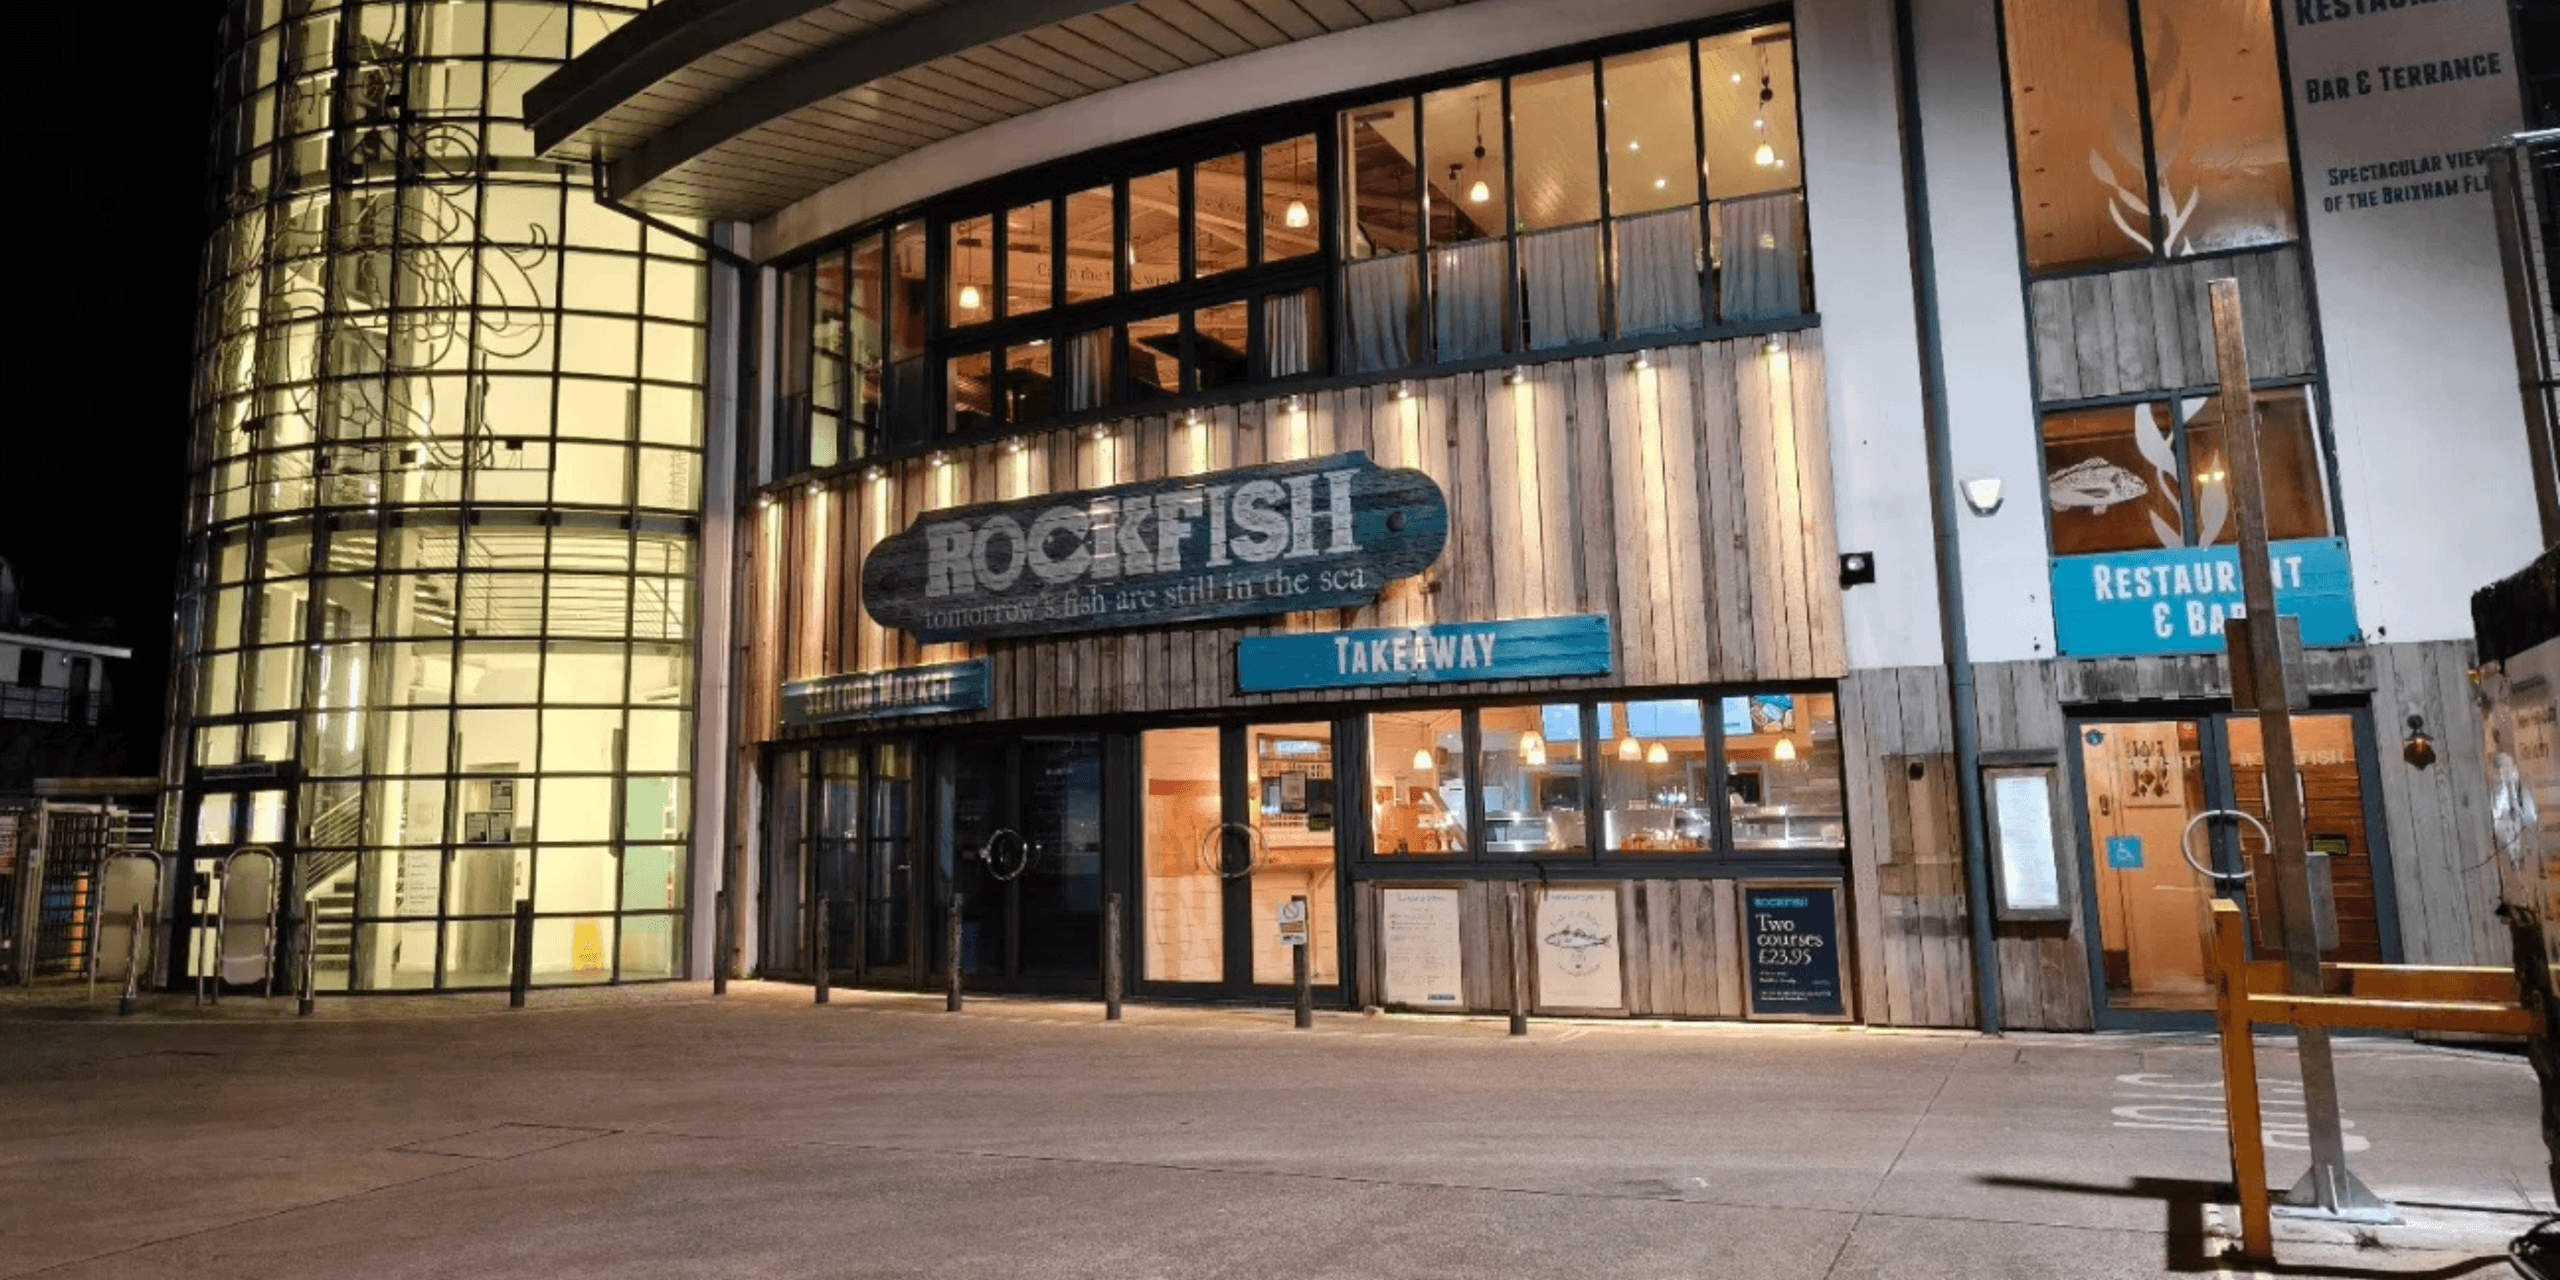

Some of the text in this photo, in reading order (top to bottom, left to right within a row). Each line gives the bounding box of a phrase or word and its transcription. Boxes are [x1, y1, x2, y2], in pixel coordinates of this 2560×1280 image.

[2306, 52, 2502, 104] BAR & TERRANCE
[2327, 155, 2442, 186] SPECTACULAR
[2324, 195, 2343, 213] OF
[2347, 190, 2379, 209] THE
[2382, 179, 2459, 204] BRIXHAM
[925, 468, 1363, 597] ROCKFISH
[2093, 556, 2302, 600] RESTAURNT
[925, 568, 1368, 629] tomorrow's fish are still in the sea
[2153, 602, 2173, 639] &
[1334, 632, 1497, 675] TAKEAWAY
[1755, 913, 1796, 931] Two
[1757, 933, 1824, 948] courses
[1758, 948, 1812, 965] £23.95
